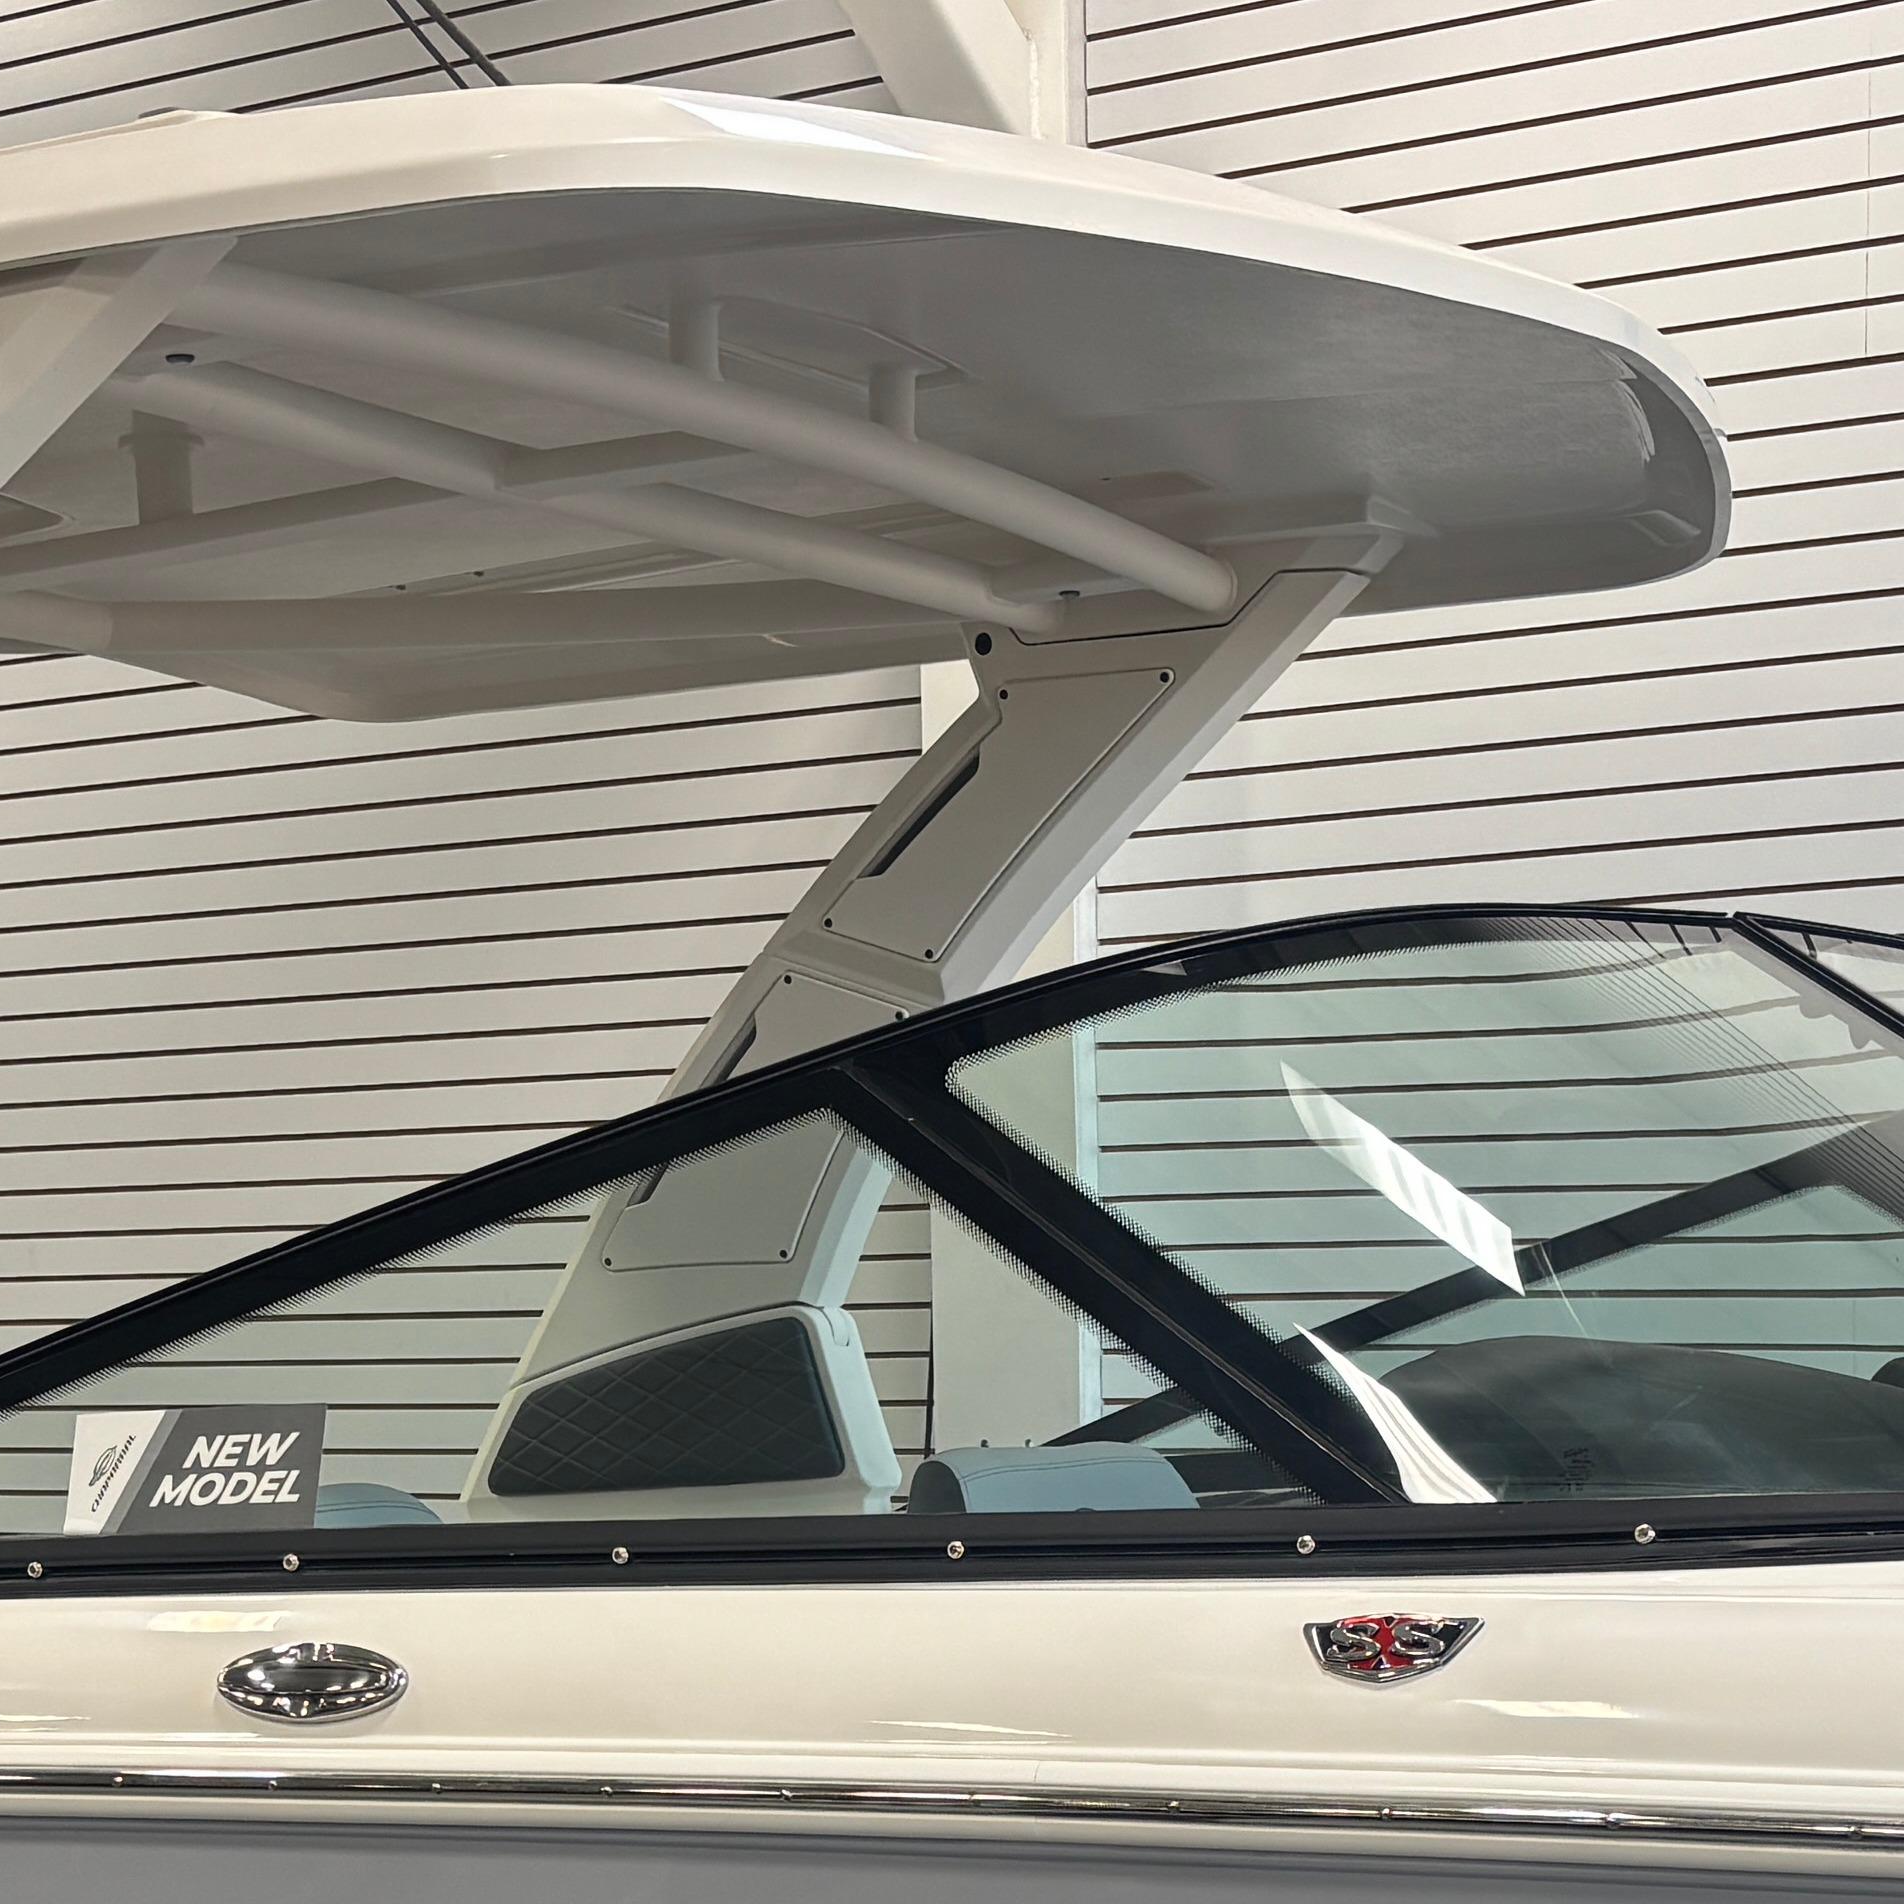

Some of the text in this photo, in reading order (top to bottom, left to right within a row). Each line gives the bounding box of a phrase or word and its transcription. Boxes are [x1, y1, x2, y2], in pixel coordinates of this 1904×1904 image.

[182, 1431, 300, 1469] NEW
[149, 1469, 301, 1508] MODEL
[1326, 1621, 1446, 1660] SS
